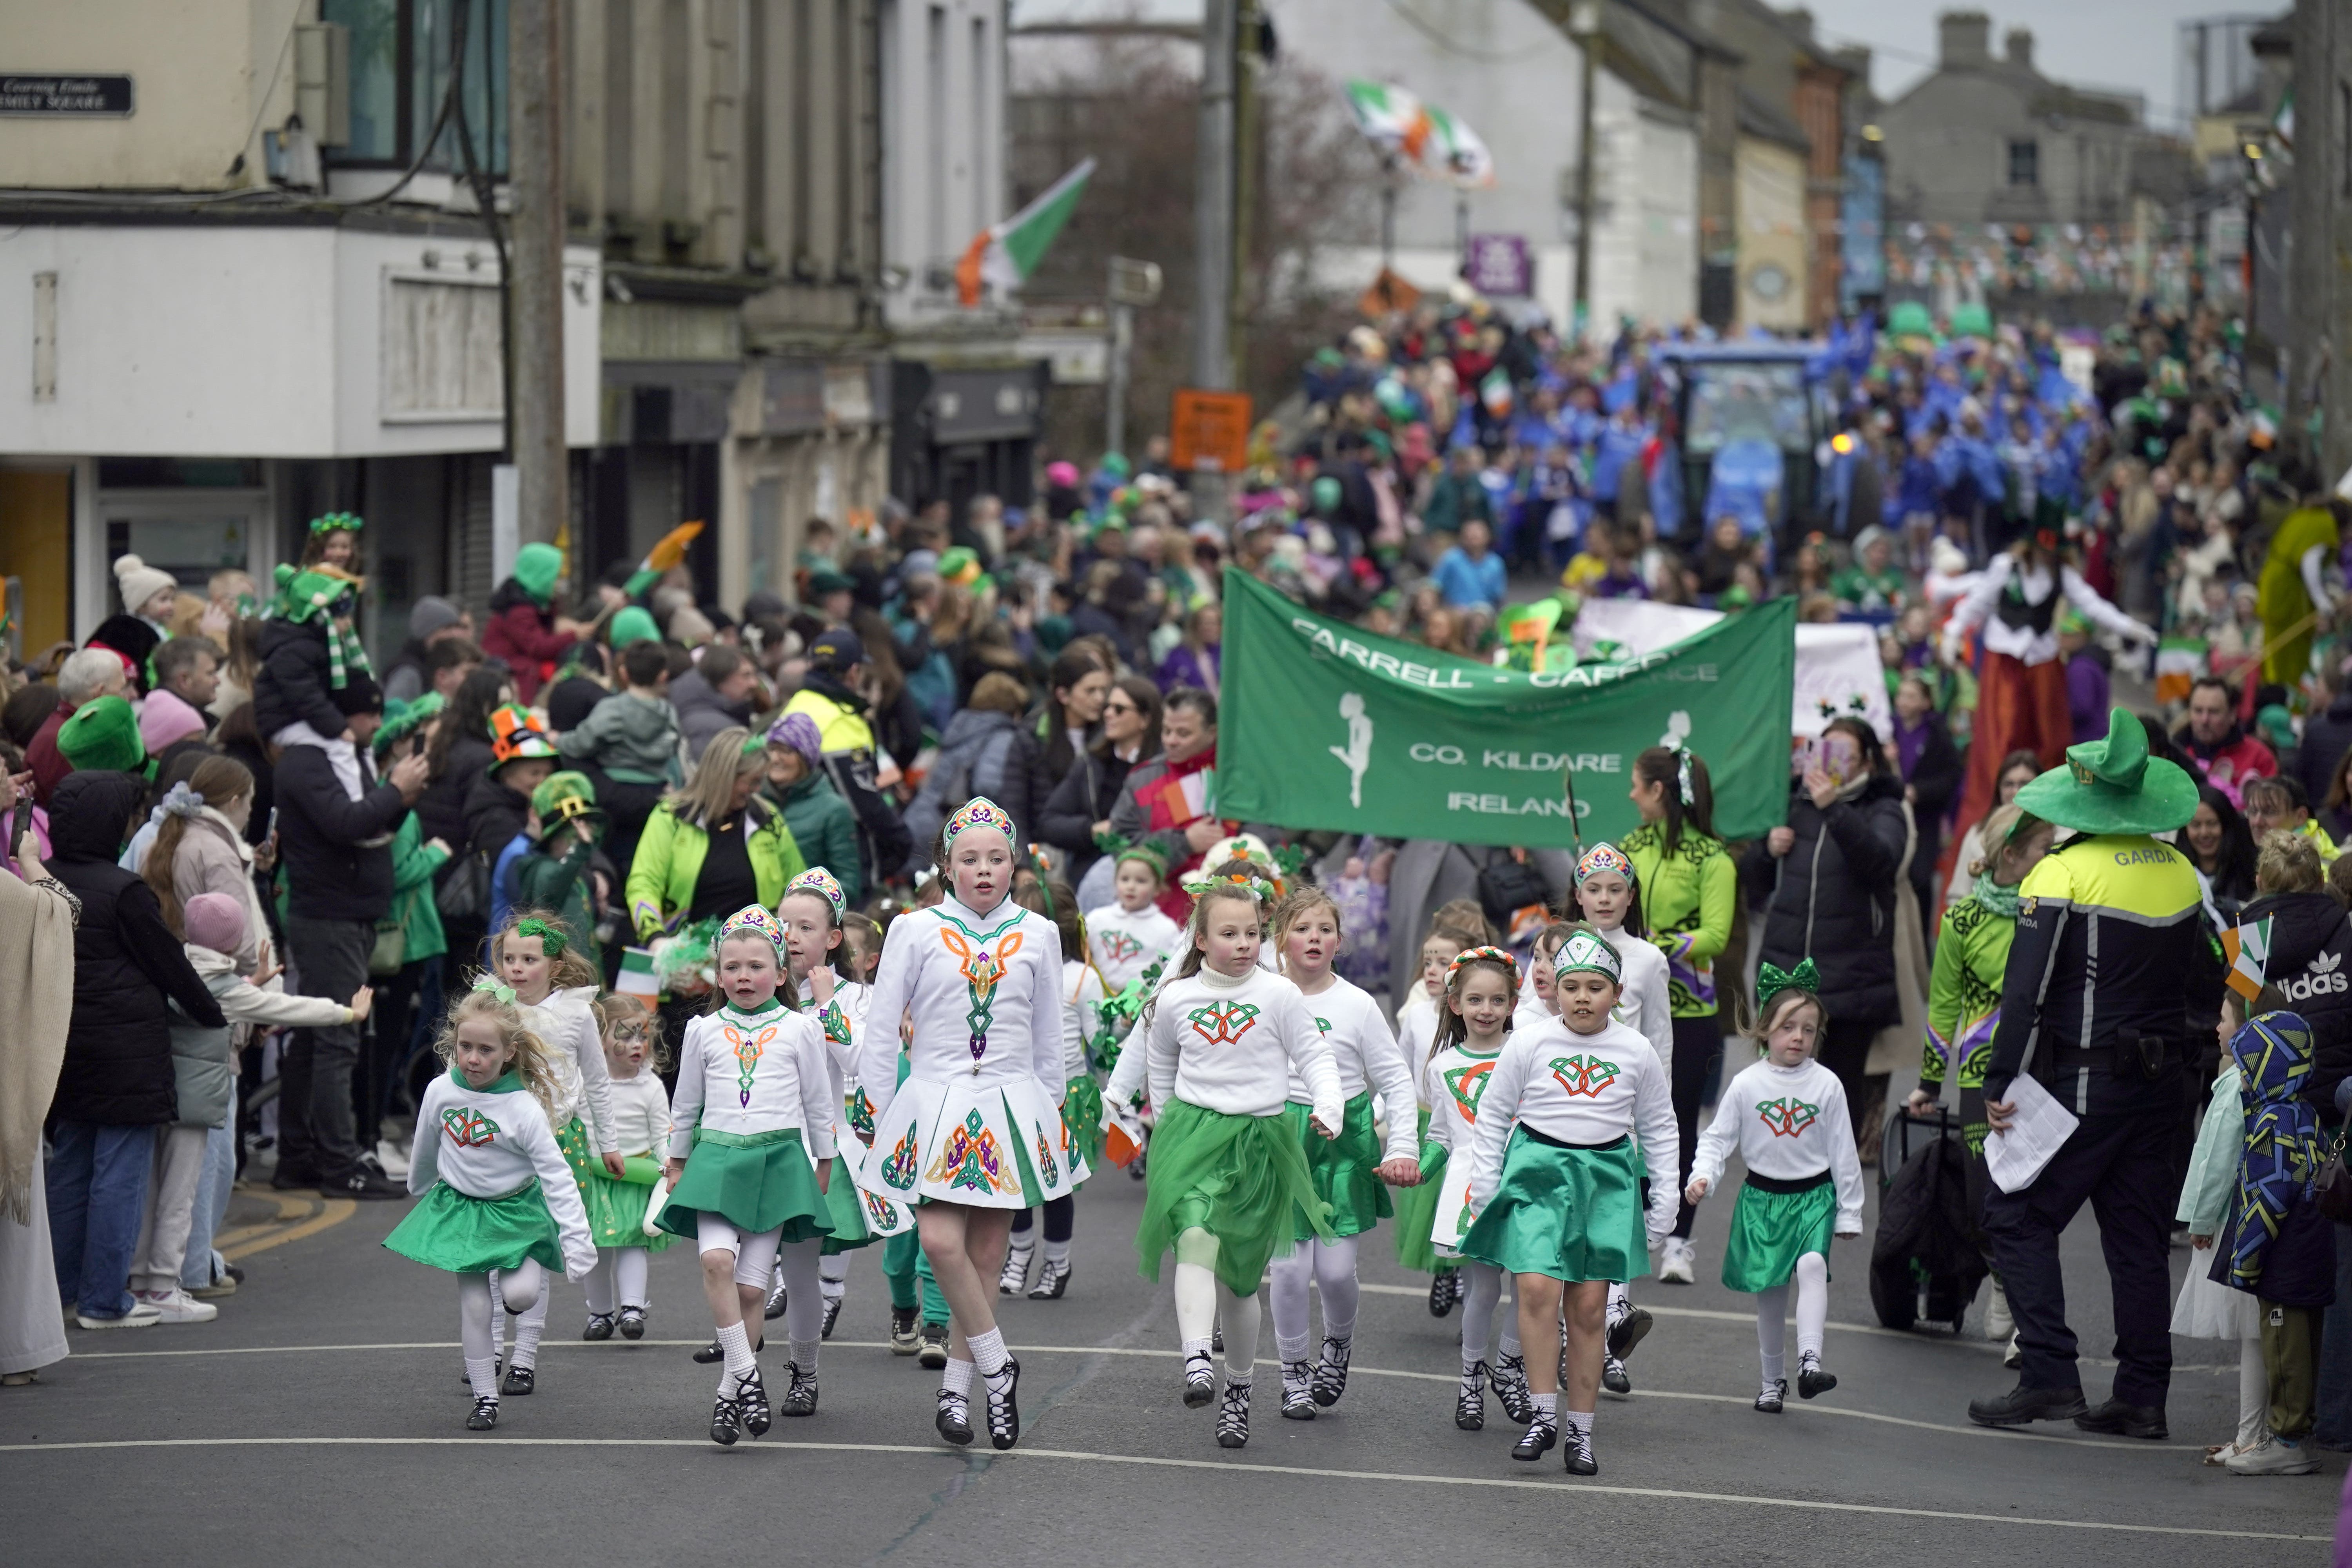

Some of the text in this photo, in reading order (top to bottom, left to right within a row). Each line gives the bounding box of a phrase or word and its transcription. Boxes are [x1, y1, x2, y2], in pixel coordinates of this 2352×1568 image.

[47, 94, 106, 111] SQUARE
[1410, 743, 1622, 773] CO. KILDARE
[1447, 791, 1591, 819] IRELAND
[2114, 849, 2177, 866] GARDA
[2018, 916, 2037, 929] RDA
[2277, 972, 2348, 1003] idas
